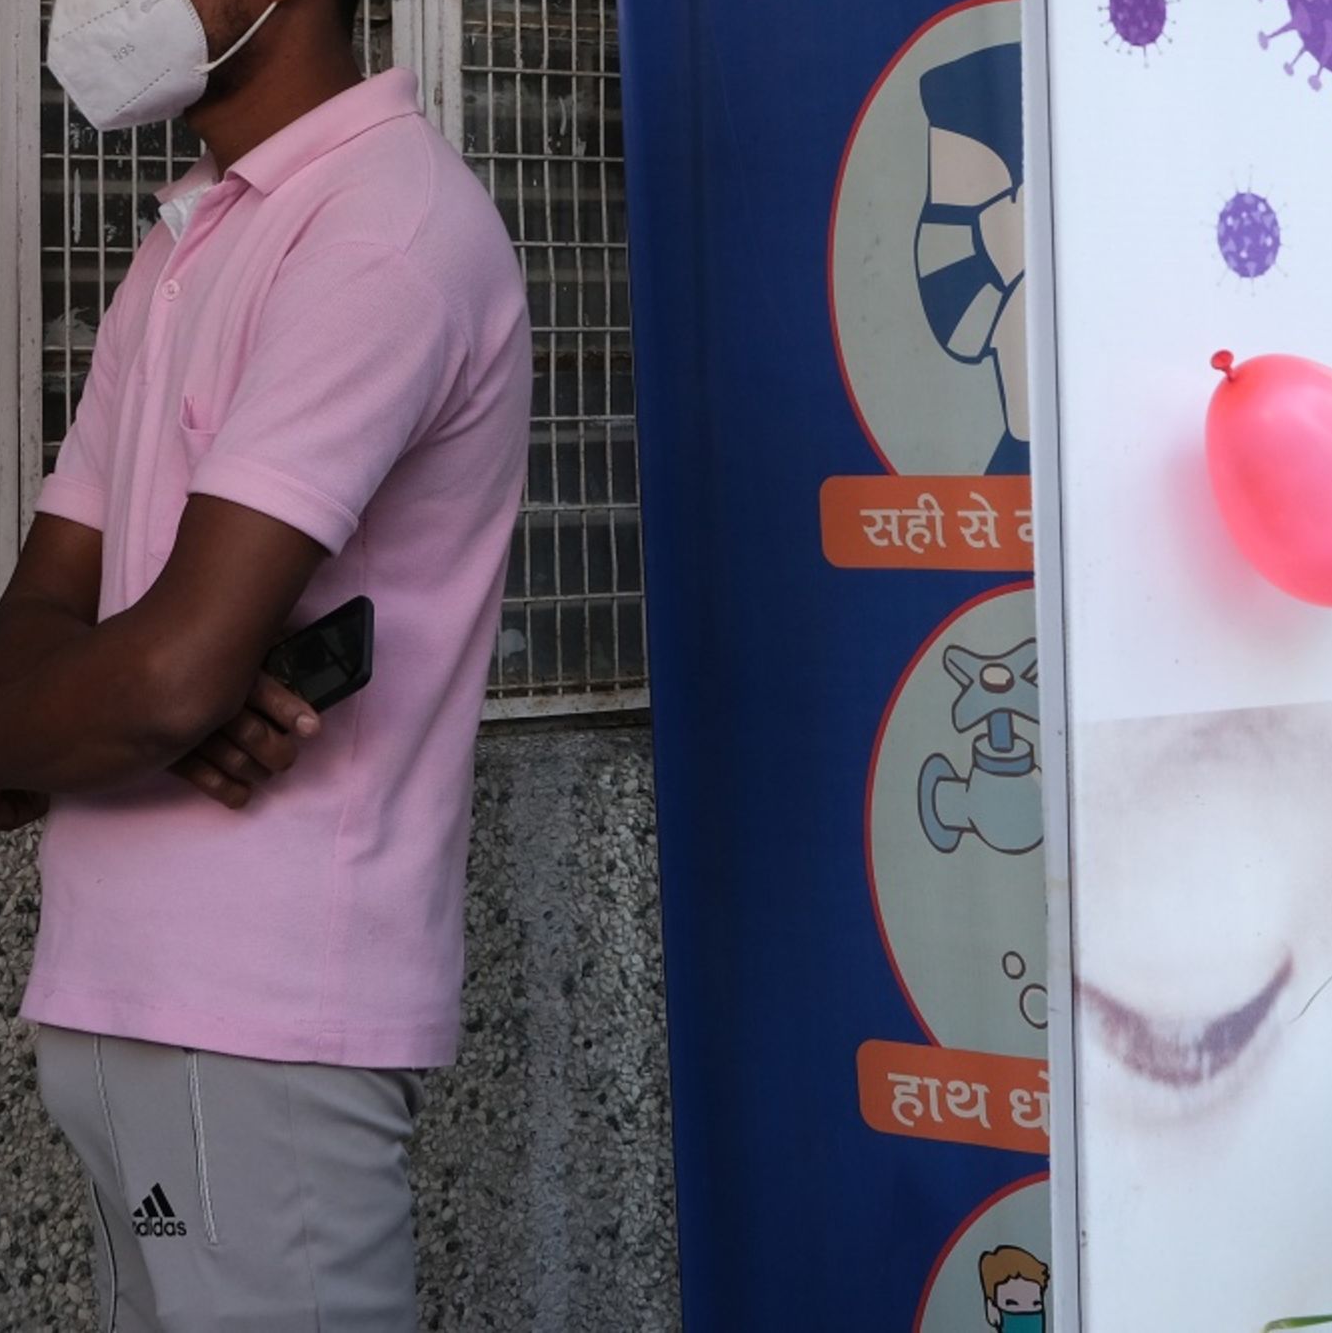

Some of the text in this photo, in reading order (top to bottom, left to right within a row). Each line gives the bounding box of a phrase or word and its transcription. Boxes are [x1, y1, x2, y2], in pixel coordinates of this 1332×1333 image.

[859, 492, 948, 555] सही
[956, 491, 1002, 549] से
[887, 1072, 993, 1131] हाथ
